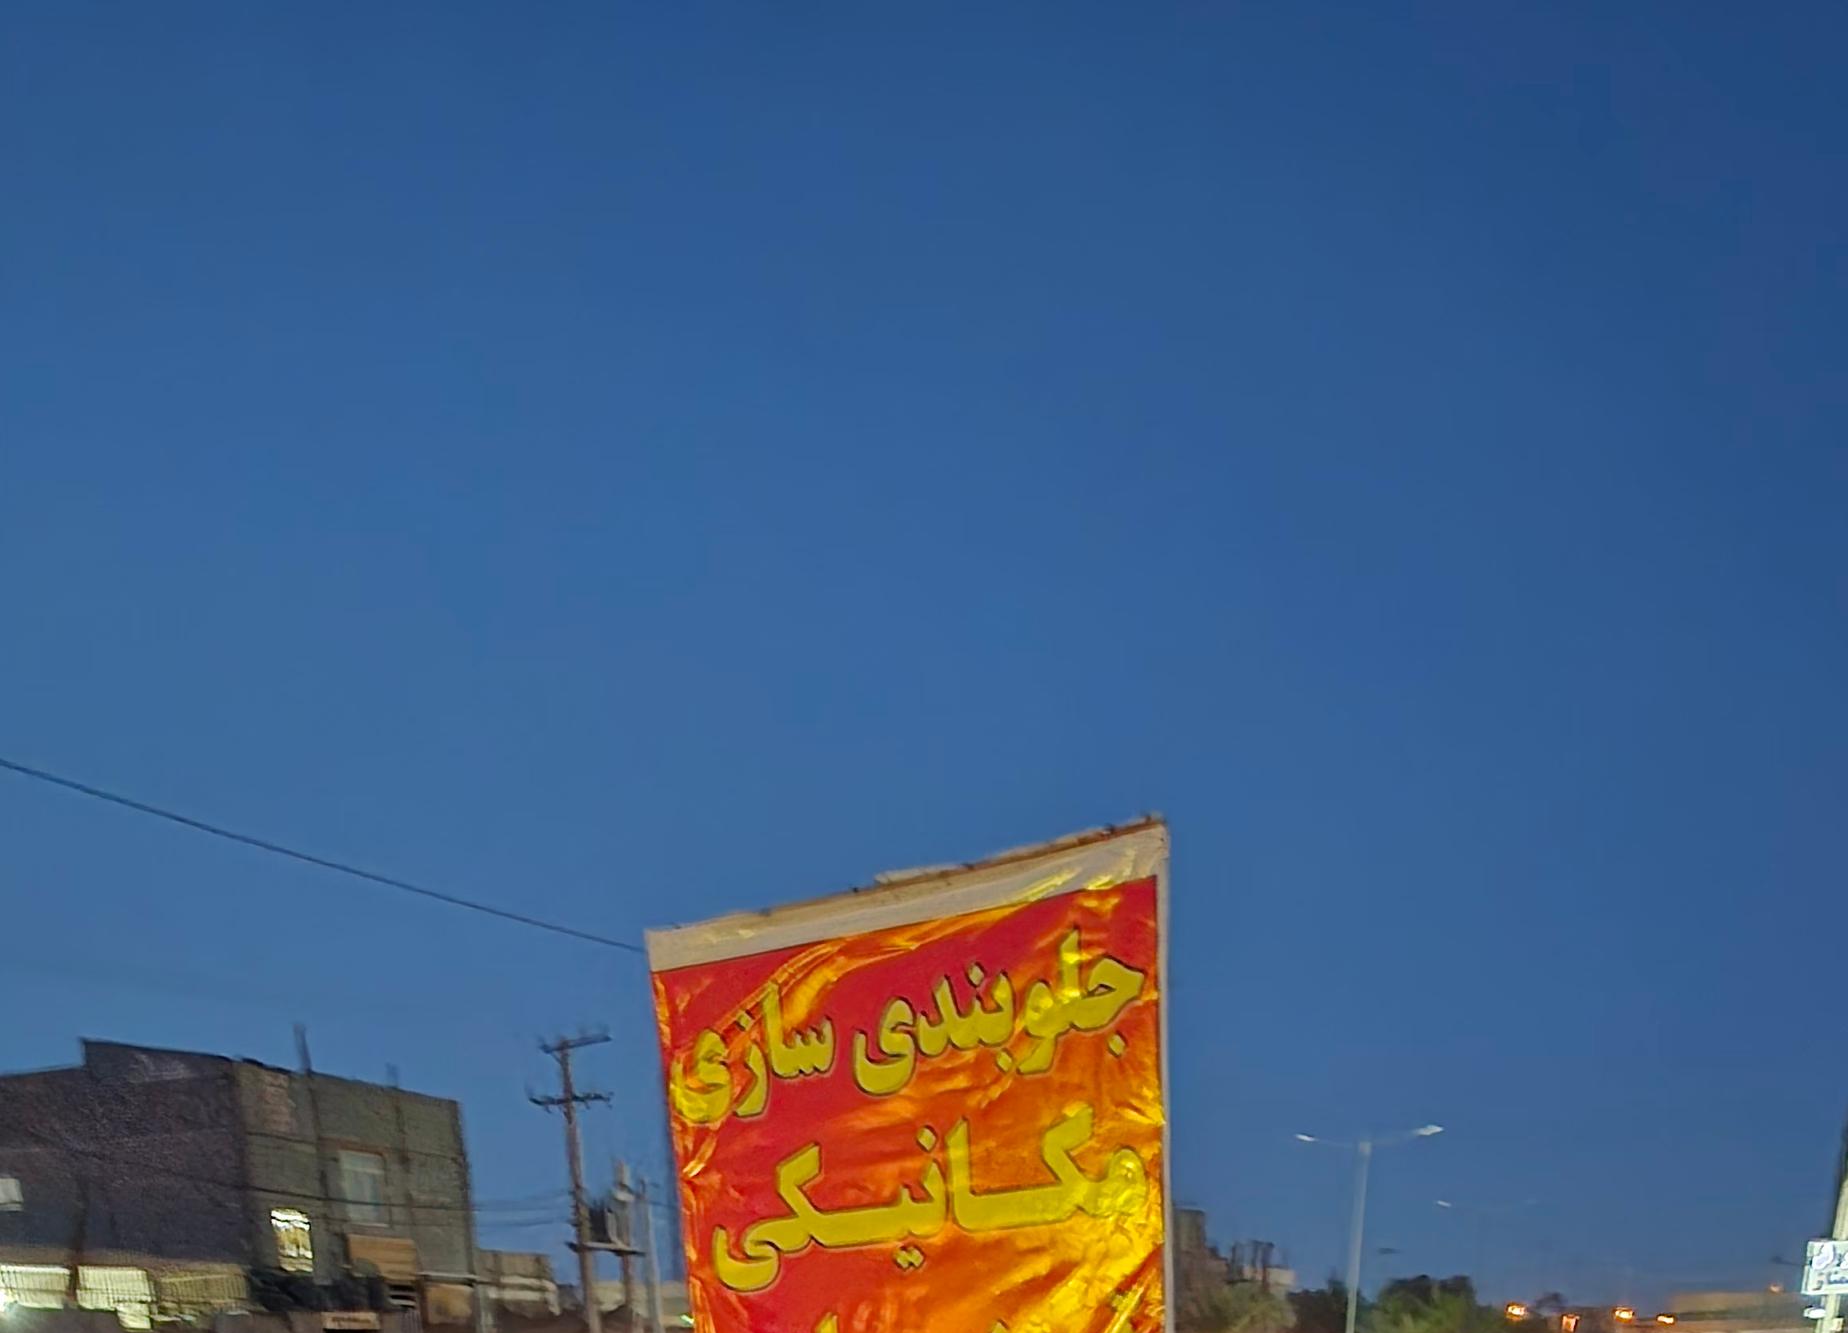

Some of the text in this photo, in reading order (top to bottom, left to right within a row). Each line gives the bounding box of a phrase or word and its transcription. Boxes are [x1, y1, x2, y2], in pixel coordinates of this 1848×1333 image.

[670, 927, 1147, 1124] جلوبندی سازی
[711, 1103, 1149, 1294] مکانیکی
